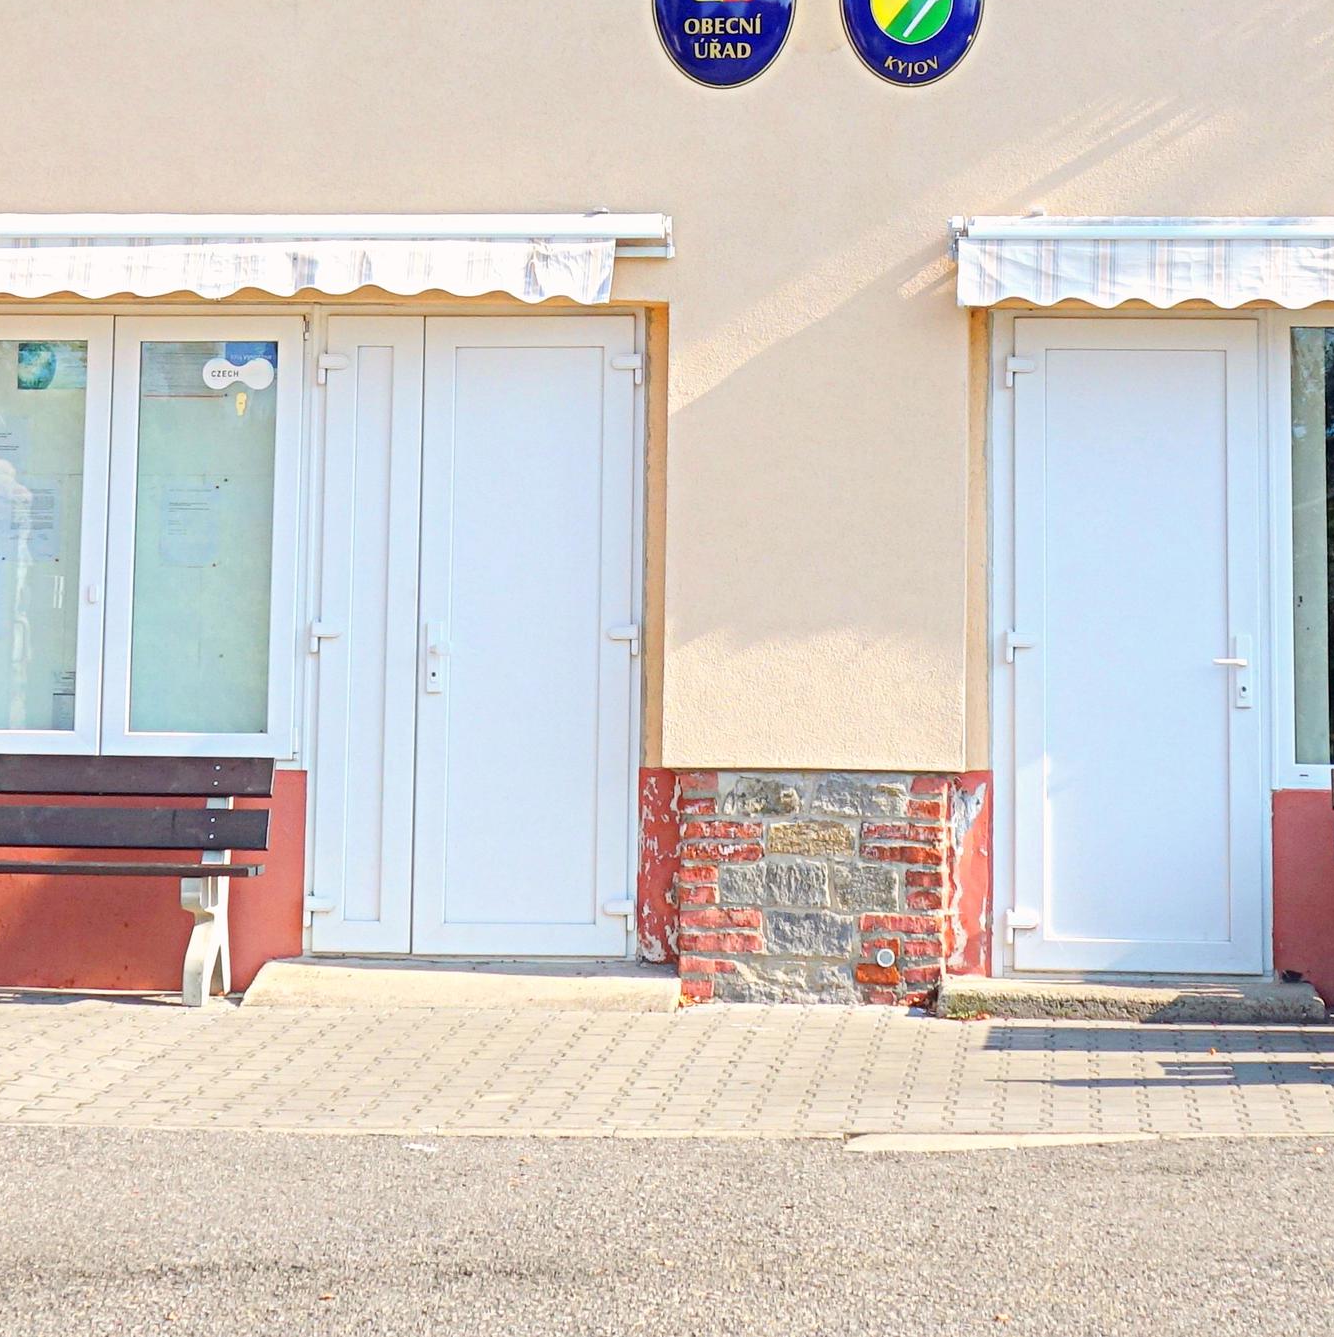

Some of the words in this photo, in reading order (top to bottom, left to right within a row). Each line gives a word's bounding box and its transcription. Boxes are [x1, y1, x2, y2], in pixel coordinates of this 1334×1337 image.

[683, 13, 762, 35] OBECNÍ
[694, 38, 752, 59] ÚŘAD
[884, 55, 940, 78] KYJOV
[210, 370, 239, 378] CZECH
